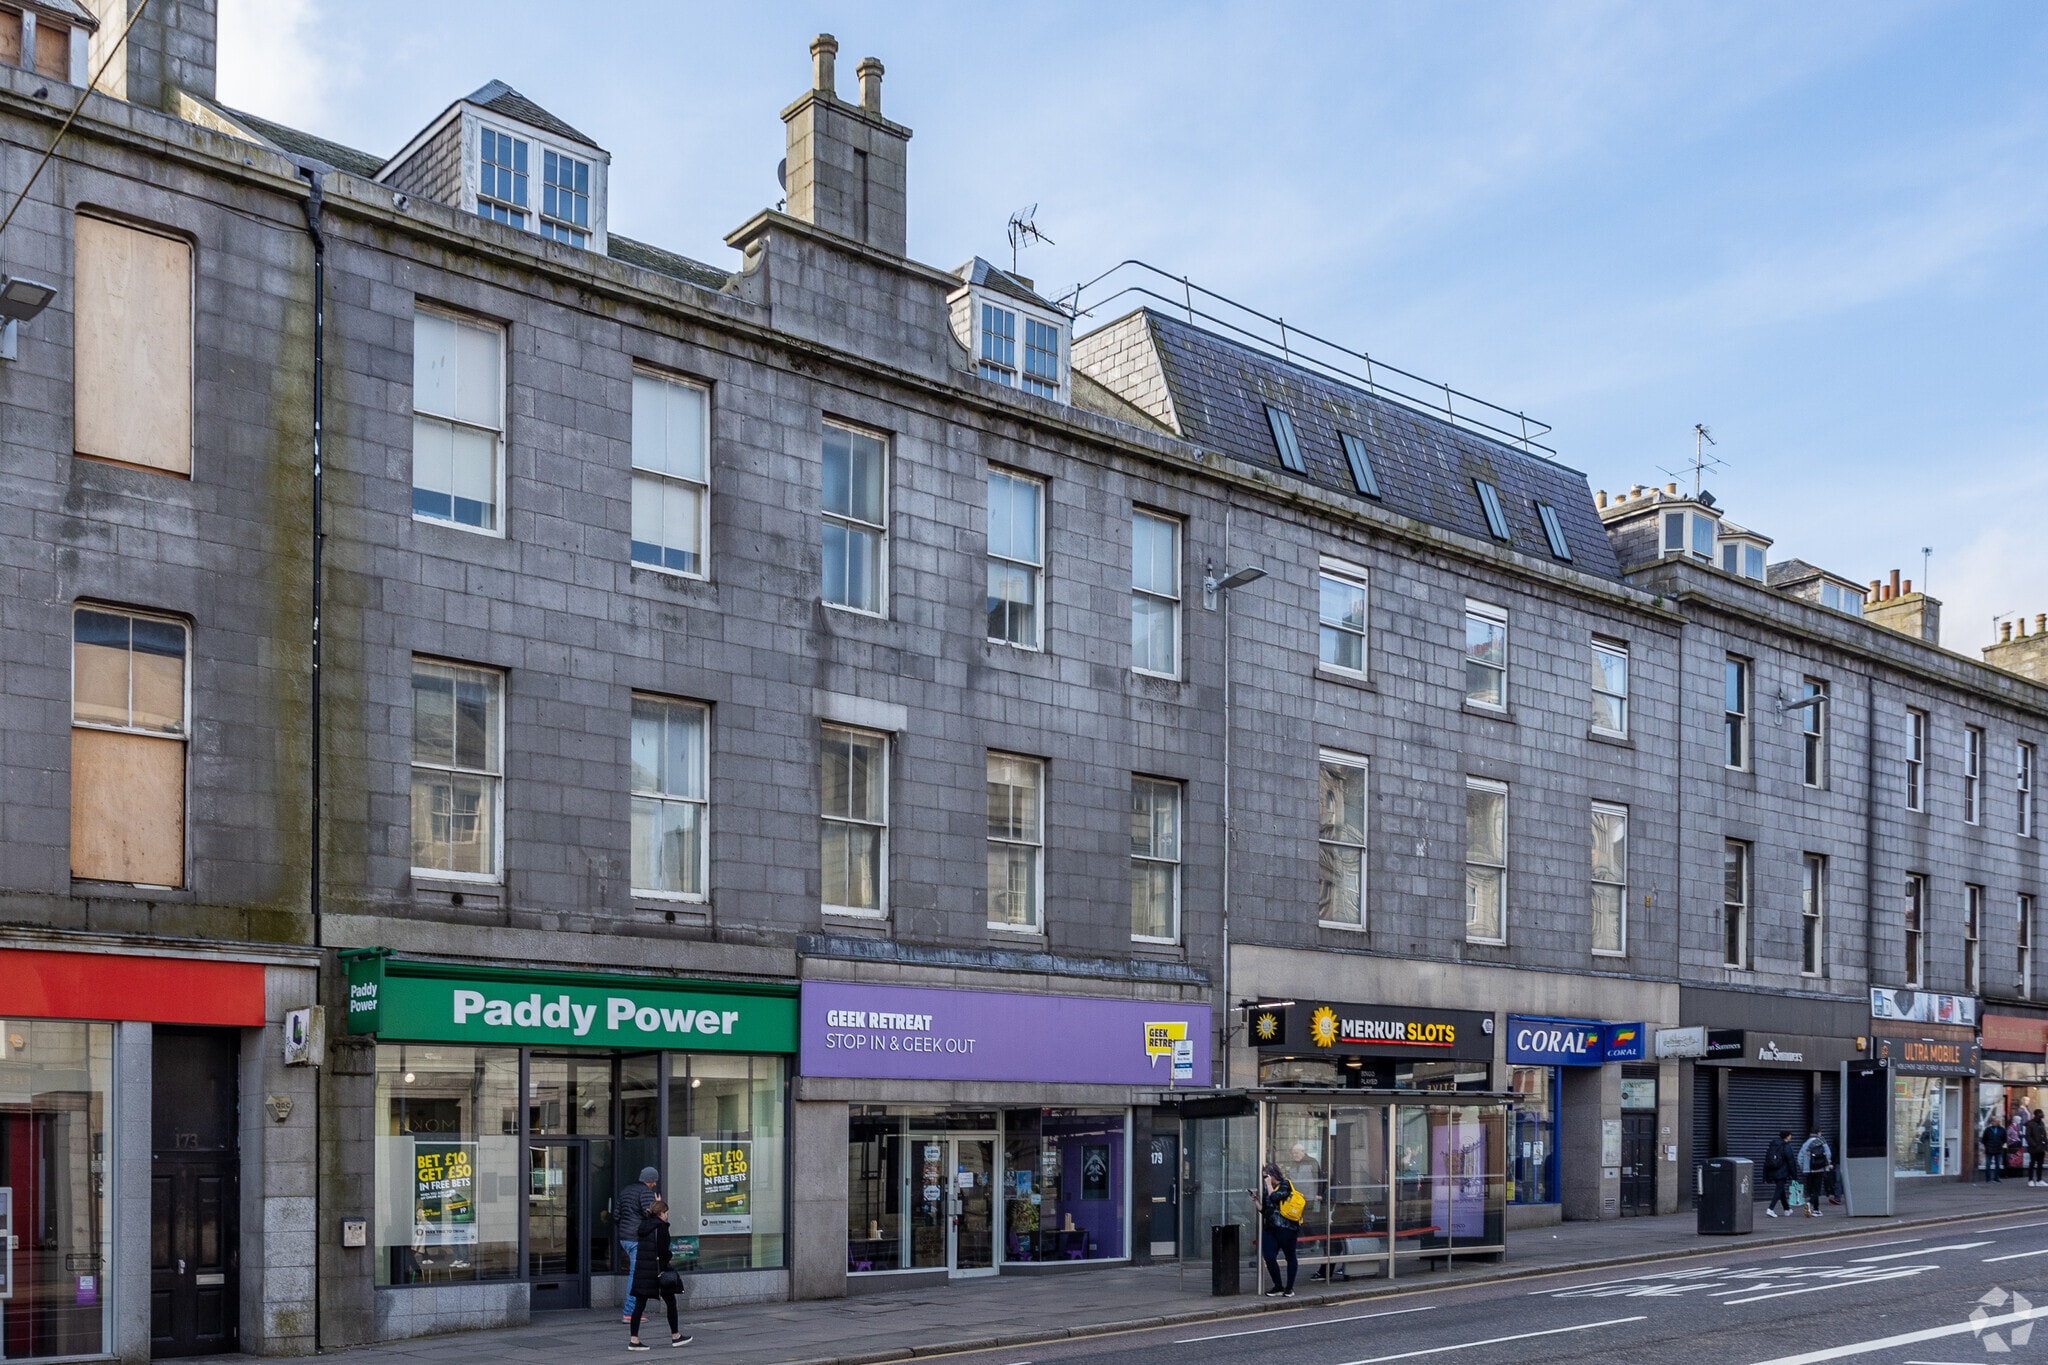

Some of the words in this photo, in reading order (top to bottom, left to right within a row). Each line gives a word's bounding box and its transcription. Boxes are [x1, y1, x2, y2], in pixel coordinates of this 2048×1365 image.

[351, 982, 377, 998] Paddy
[350, 999, 377, 1013] Power
[453, 989, 597, 1036] Paddy
[607, 997, 739, 1034] Power
[826, 1009, 866, 1028] GEEK
[868, 1012, 932, 1031] RETREAT
[1149, 1028, 1168, 1038] GEEK
[1341, 1019, 1406, 1040] MERKUR
[1407, 1022, 1455, 1043] SLOTS
[826, 1033, 866, 1049] STOP
[870, 1035, 885, 1050] IN
[889, 1036, 900, 1051] &
[902, 1037, 942, 1053] GEEK
[945, 1038, 975, 1054] OUT
[1516, 1029, 1587, 1054] CORAL
[1607, 1048, 1637, 1057] CORAL
[1904, 1042, 1929, 1061] ULTRA
[1930, 1044, 1960, 1063] MOBILE
[175, 1133, 199, 1149] 173
[417, 1154, 440, 1168] BET
[445, 1151, 467, 1166] £10
[703, 1151, 722, 1165] BET
[725, 1149, 743, 1163] £10
[1151, 1152, 1163, 1164] 179
[418, 1168, 443, 1181] GET
[447, 1164, 472, 1180] £50
[703, 1163, 724, 1177] GET
[727, 1161, 747, 1175] £50
[419, 1181, 430, 1192] IN
[431, 1180, 450, 1189] FREE
[452, 1178, 471, 1187] BETS
[705, 1177, 712, 1185] IN
[713, 1175, 729, 1184] FREE
[731, 1173, 746, 1182] BETS
[1551, 1282, 1808, 1298] ONLY
